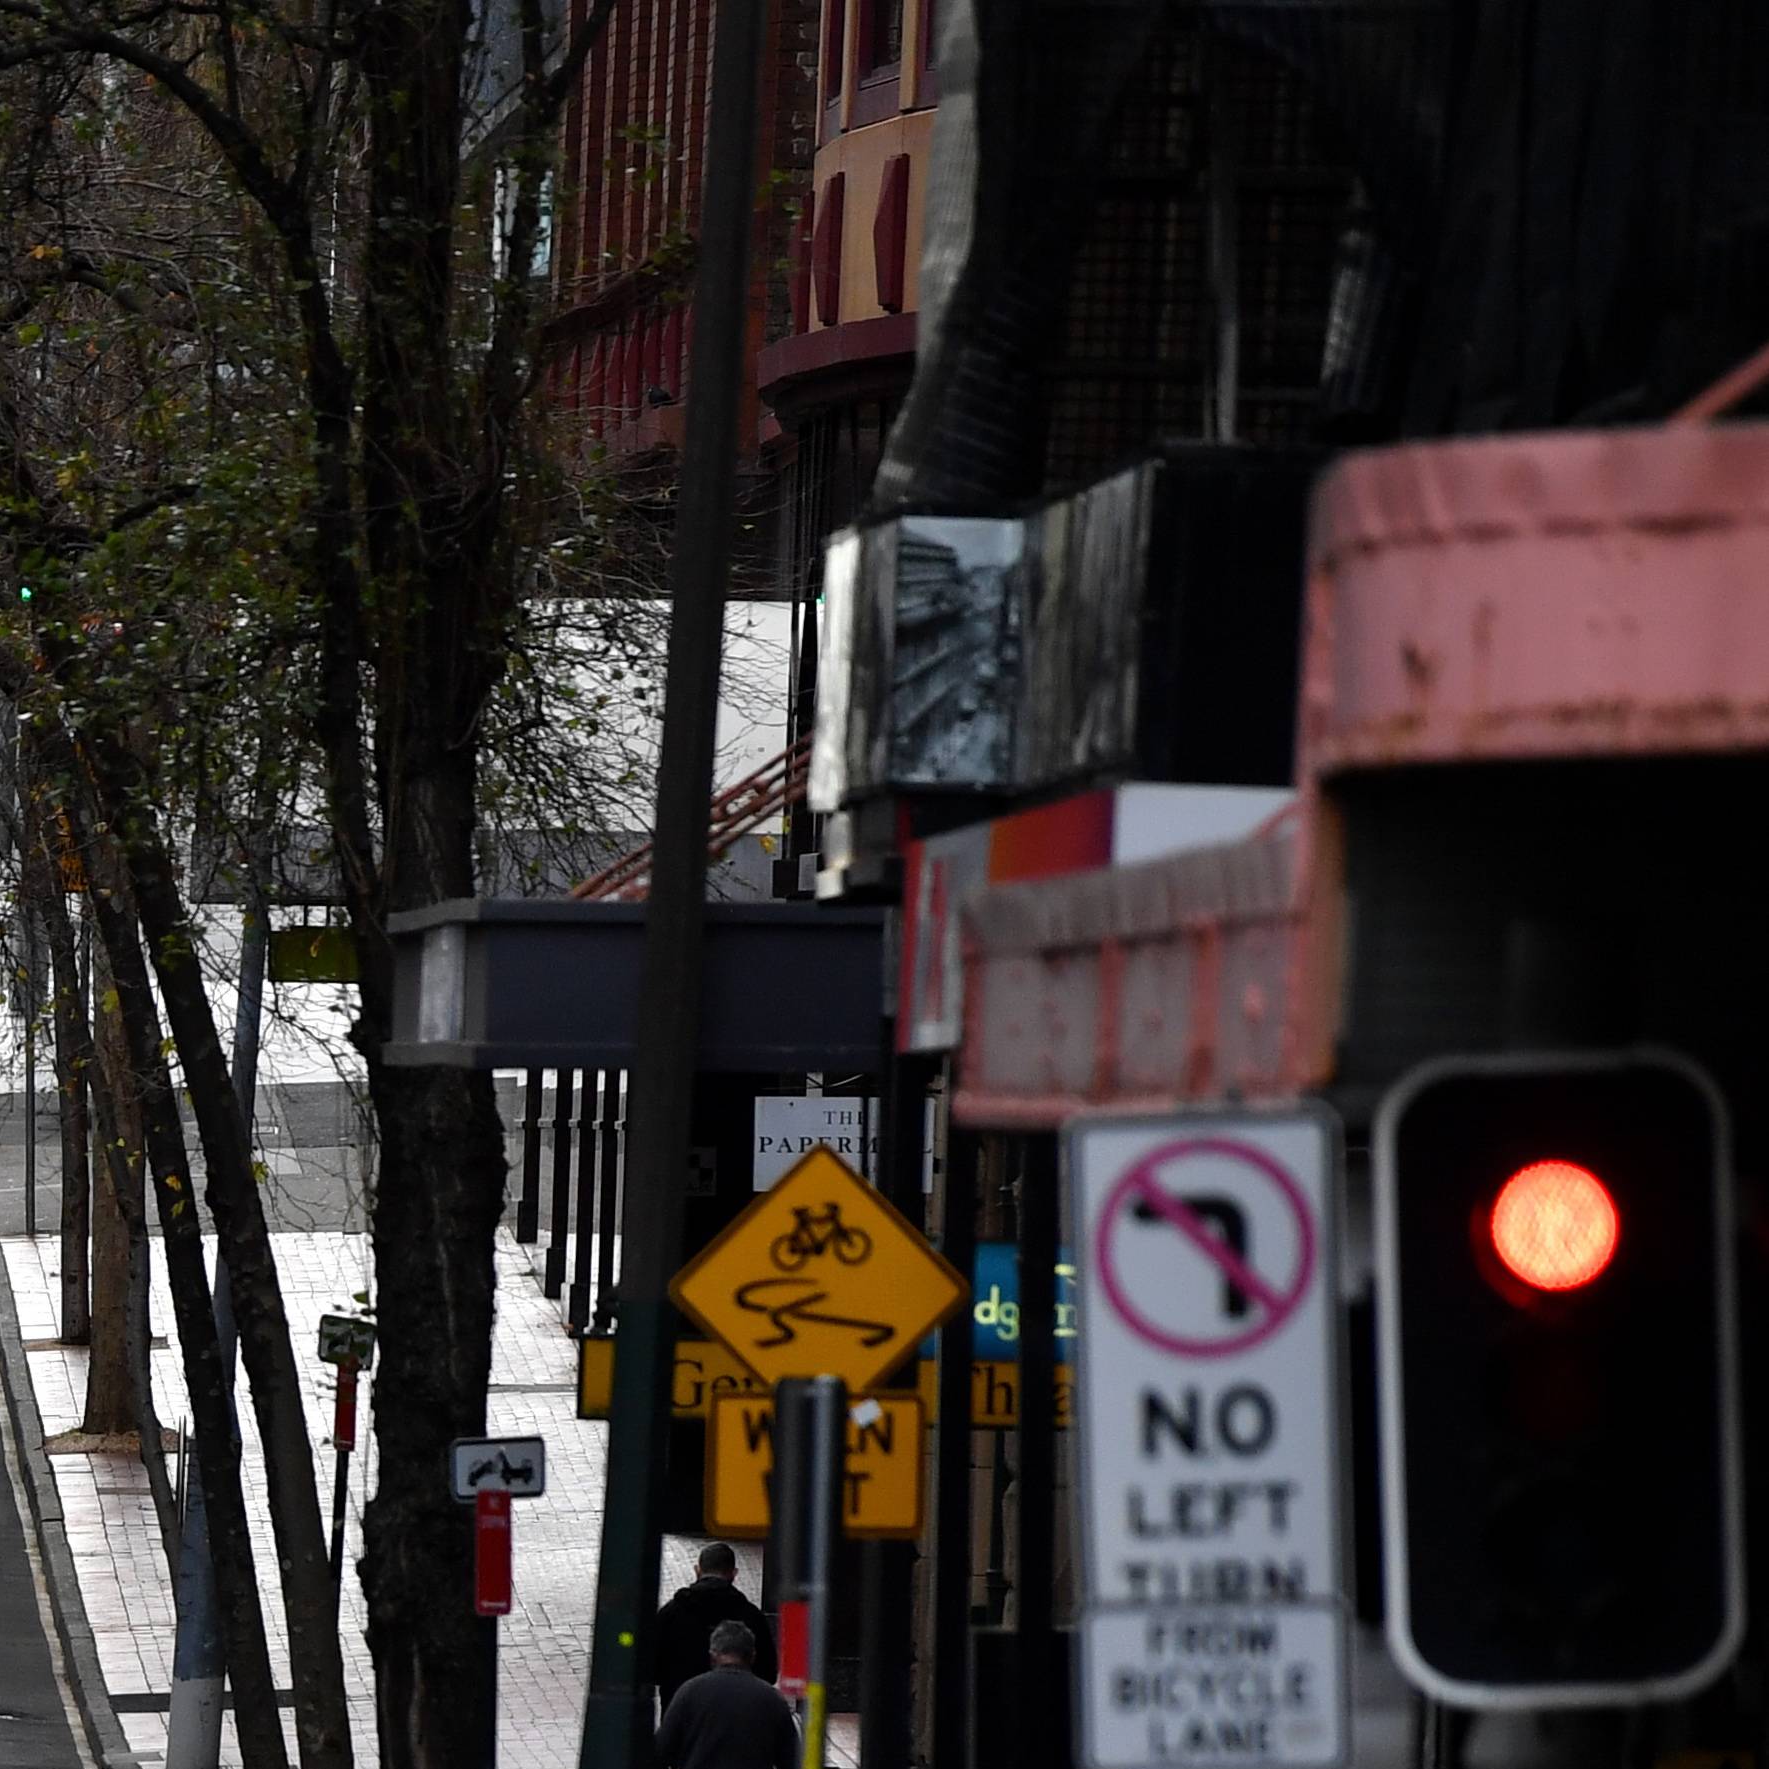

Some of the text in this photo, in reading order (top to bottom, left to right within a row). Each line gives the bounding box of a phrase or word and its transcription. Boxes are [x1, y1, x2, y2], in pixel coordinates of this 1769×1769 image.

[1141, 1386, 1275, 1457] NO
[1127, 1484, 1295, 1542] LEFT
[1120, 1561, 1306, 1603] TURN
[1145, 1617, 1277, 1657] FROM
[1111, 1666, 1310, 1710] BICYCLE
[1149, 1722, 1271, 1759] LANE
